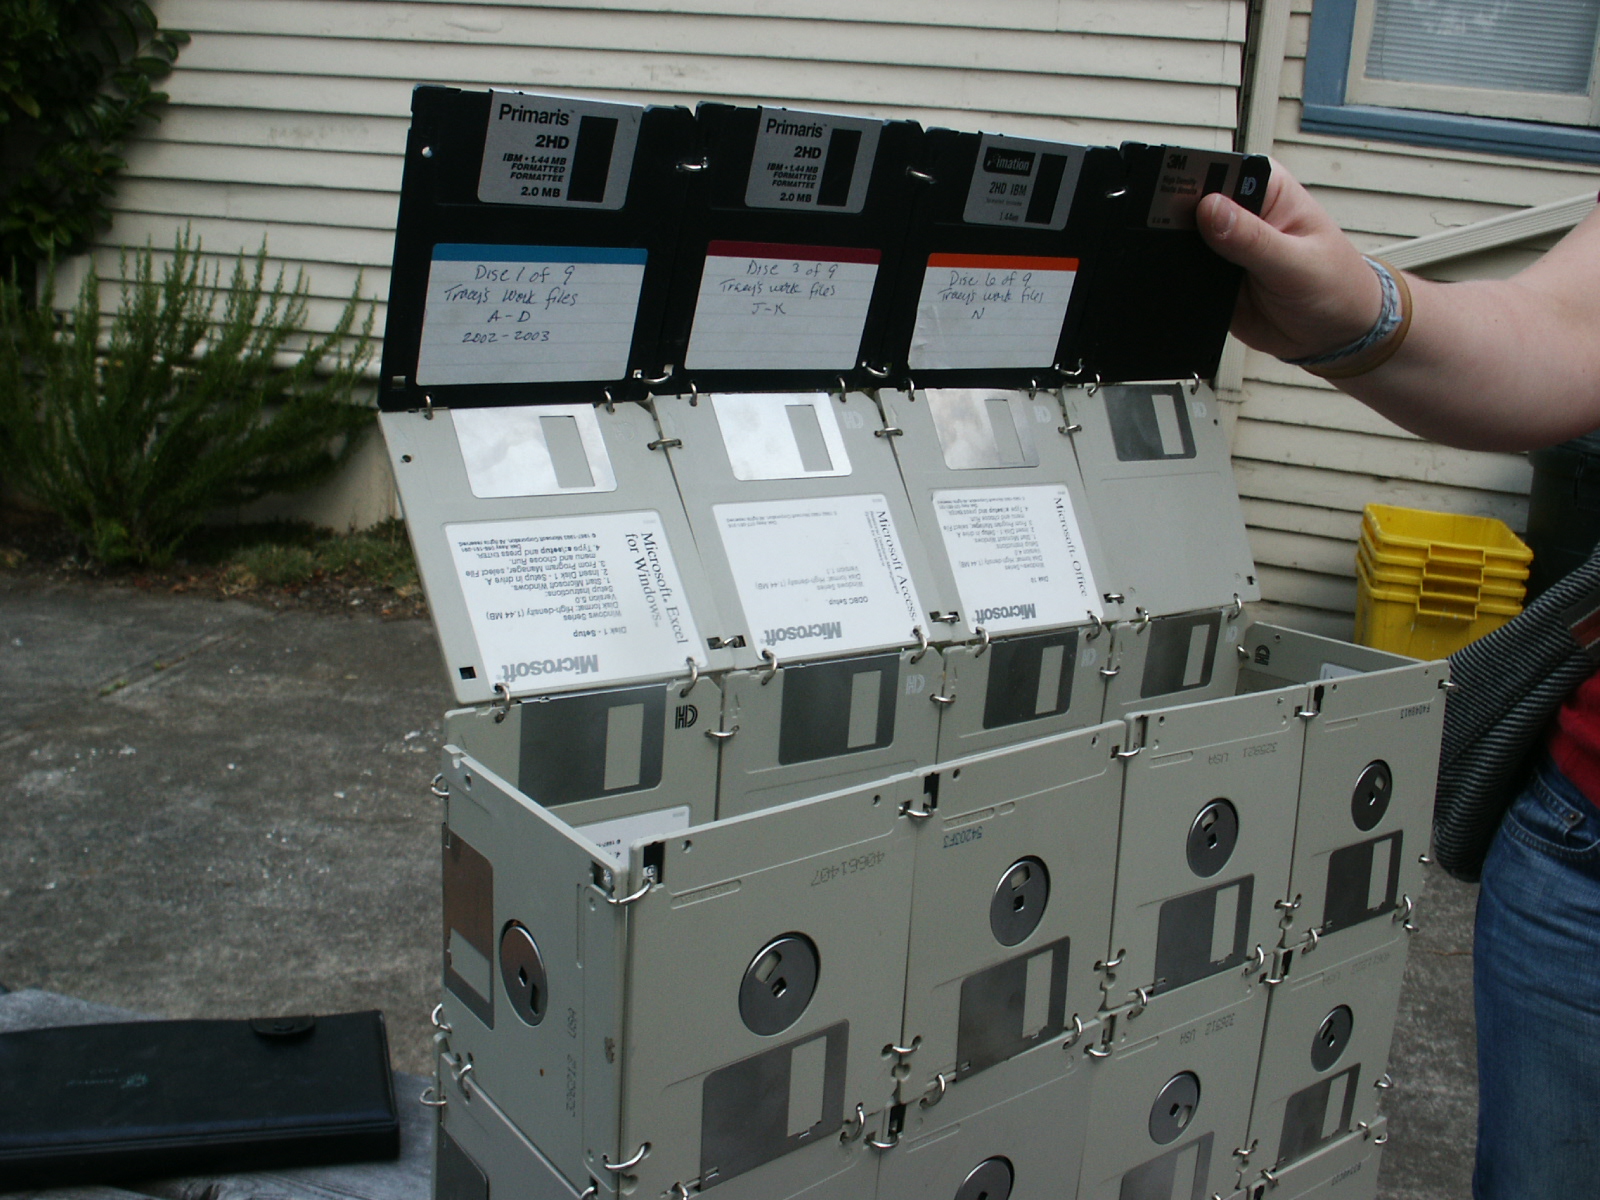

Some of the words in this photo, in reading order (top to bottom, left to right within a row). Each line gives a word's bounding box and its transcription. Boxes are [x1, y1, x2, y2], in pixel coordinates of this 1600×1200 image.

[498, 103, 570, 126] Primaris
[765, 118, 823, 138] Primaris
[535, 134, 570, 149] 2HD
[793, 145, 822, 159] 2HD
[502, 152, 523, 162] IBM
[531, 155, 550, 164] 1.44
[550, 157, 567, 166] MB
[1167, 153, 1188, 170] 3M
[511, 162, 566, 173] FORMATTED
[767, 162, 783, 172] IBM
[789, 165, 805, 173] 1.44
[805, 166, 819, 174] MB
[510, 171, 564, 183] FORMATTEE
[773, 171, 817, 181] FORMATTED
[772, 179, 815, 189] FORMATTEE
[989, 181, 1007, 195] 2HD
[1010, 183, 1027, 196] IBM
[520, 186, 539, 197] 2.0
[541, 187, 561, 198] MB
[780, 192, 796, 202] 2.0
[797, 193, 812, 203] MB
[474, 263, 510, 282] Disc
[529, 266, 550, 283] of
[563, 264, 576, 285] 9
[746, 259, 779, 275] Disc
[792, 262, 800, 273] 3
[805, 262, 822, 277] of
[828, 263, 839, 279] 9
[949, 270, 979, 287] Disc
[985, 272, 996, 287] 6
[1001, 270, 1017, 286] of
[1022, 272, 1033, 287] 9
[809, 281, 836, 300] files
[544, 286, 579, 310] files
[971, 307, 985, 320] N
[625, 533, 640, 554] for
[876, 510, 904, 571] Microsoft
[502, 550, 523, 558] press
[524, 548, 539, 556] and
[573, 545, 592, 553] Type
[544, 563, 577, 571] Program
[577, 561, 597, 569] From
[524, 573, 547, 582] Setup
[560, 571, 577, 579] Disk
[579, 569, 600, 577] Insert
[1072, 560, 1087, 597] Office
[495, 576, 514, 584] drive
[553, 579, 585, 588] Microsoft
[585, 577, 603, 586] Start
[591, 585, 614, 594] Setup
[574, 596, 588, 604] 5.0
[589, 593, 617, 602] Version
[849, 596, 869, 604] ODBC
[526, 605, 574, 617] High-density
[602, 601, 619, 609] Disk
[486, 611, 504, 621] MB)
[505, 609, 525, 619] (1.44
[563, 612, 588, 621] Series
[587, 609, 622, 618] Windows
[975, 603, 1037, 625] Microsoft
[610, 626, 627, 634] Disk
[666, 606, 689, 644] Excel
[572, 629, 597, 638] Setup
[764, 621, 843, 647] Microsoft
[1254, 644, 1271, 666] HD
[501, 654, 600, 683] Microsoft
[906, 673, 926, 695] HD
[674, 704, 699, 729] HD
